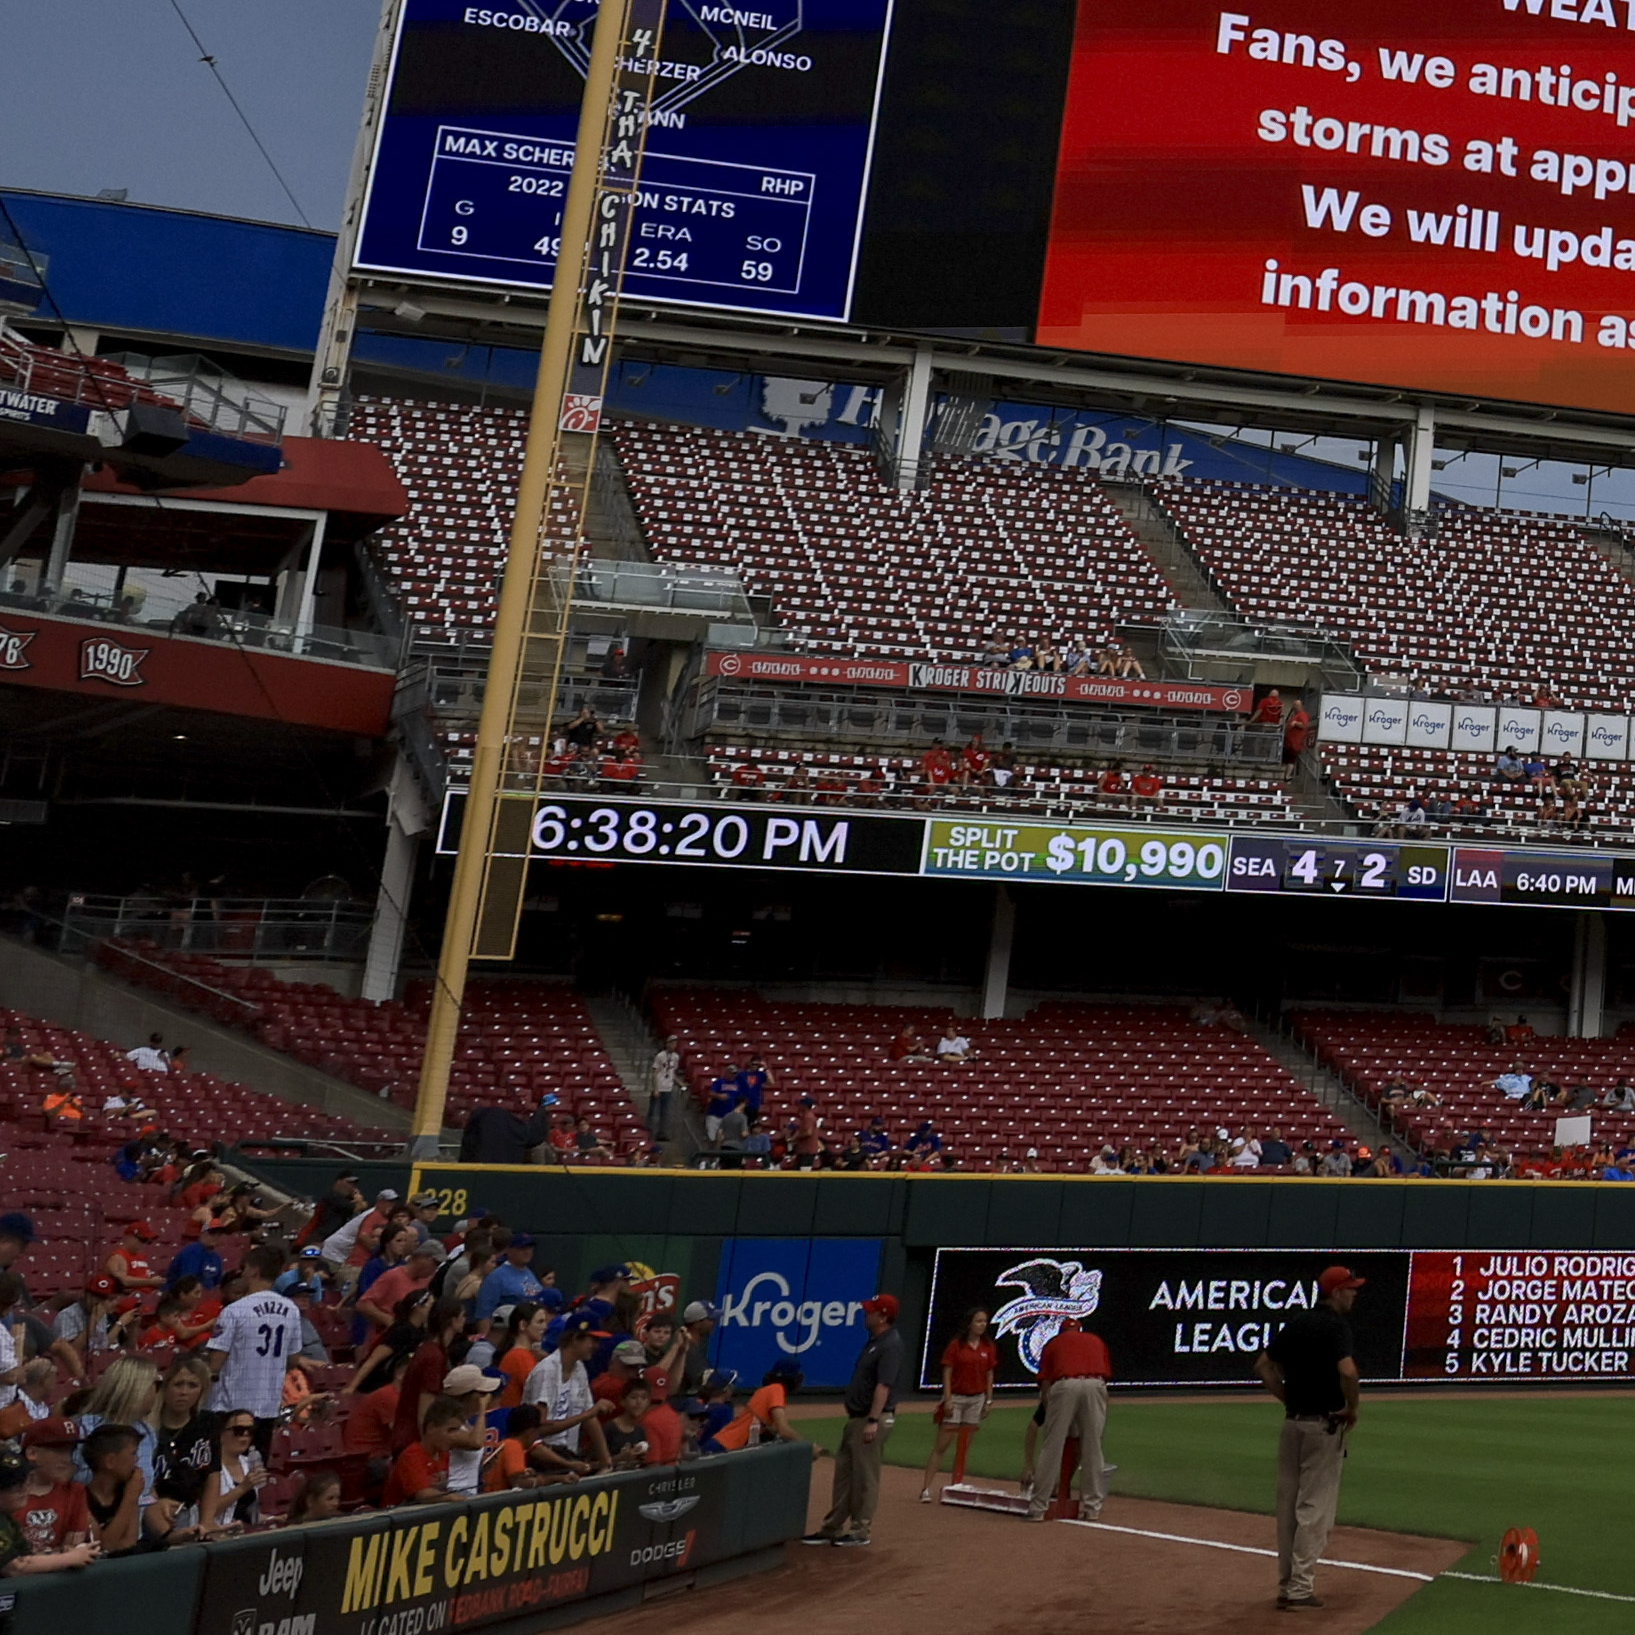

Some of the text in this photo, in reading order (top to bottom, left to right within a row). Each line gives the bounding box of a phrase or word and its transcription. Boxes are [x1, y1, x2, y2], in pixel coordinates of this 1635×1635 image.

[464, 8, 571, 37] ESCOBAR
[700, 6, 778, 31] MCNEIL
[632, 28, 652, 57] 4
[1216, 13, 1360, 84] Fans,
[1377, 50, 1454, 89] we
[723, 46, 811, 71] ALONSO
[1258, 108, 1449, 167] storms
[1464, 135, 1518, 175] at
[508, 176, 563, 197] 2022
[663, 195, 735, 218] STATS
[1301, 184, 1391, 237] We
[1407, 200, 1498, 253] will
[640, 223, 692, 242] ERA
[633, 247, 688, 271] 2.54
[581, 193, 618, 366] CHIKIN
[1262, 259, 1581, 344] information
[1065, 422, 1197, 481] Bank
[87, 644, 133, 680] 1990
[909, 664, 970, 689] KROGER
[531, 805, 847, 864] 6:38:20 PM
[949, 826, 1018, 849] SPLIT
[934, 847, 1035, 872] THE POT
[1046, 832, 1224, 882] $10,990
[1456, 869, 1498, 888] LAA
[1516, 874, 1597, 895] 6:40 PM
[1479, 1257, 1546, 1277] JULIO
[1477, 1281, 1556, 1301] JORGE
[253, 1301, 289, 1317] PIAZZA
[719, 1272, 864, 1353] Kroger
[1475, 1305, 1556, 1325] RANDY
[256, 1323, 284, 1357] 31
[1473, 1328, 1557, 1347] CEDRIC
[1471, 1351, 1628, 1372] KYLE TUCKER
[341, 1522, 440, 1614] MIKE
[444, 1490, 619, 1588] CASTRUCCI
[630, 1540, 686, 1565] DODGE
[259, 1548, 303, 1599] Jeep
